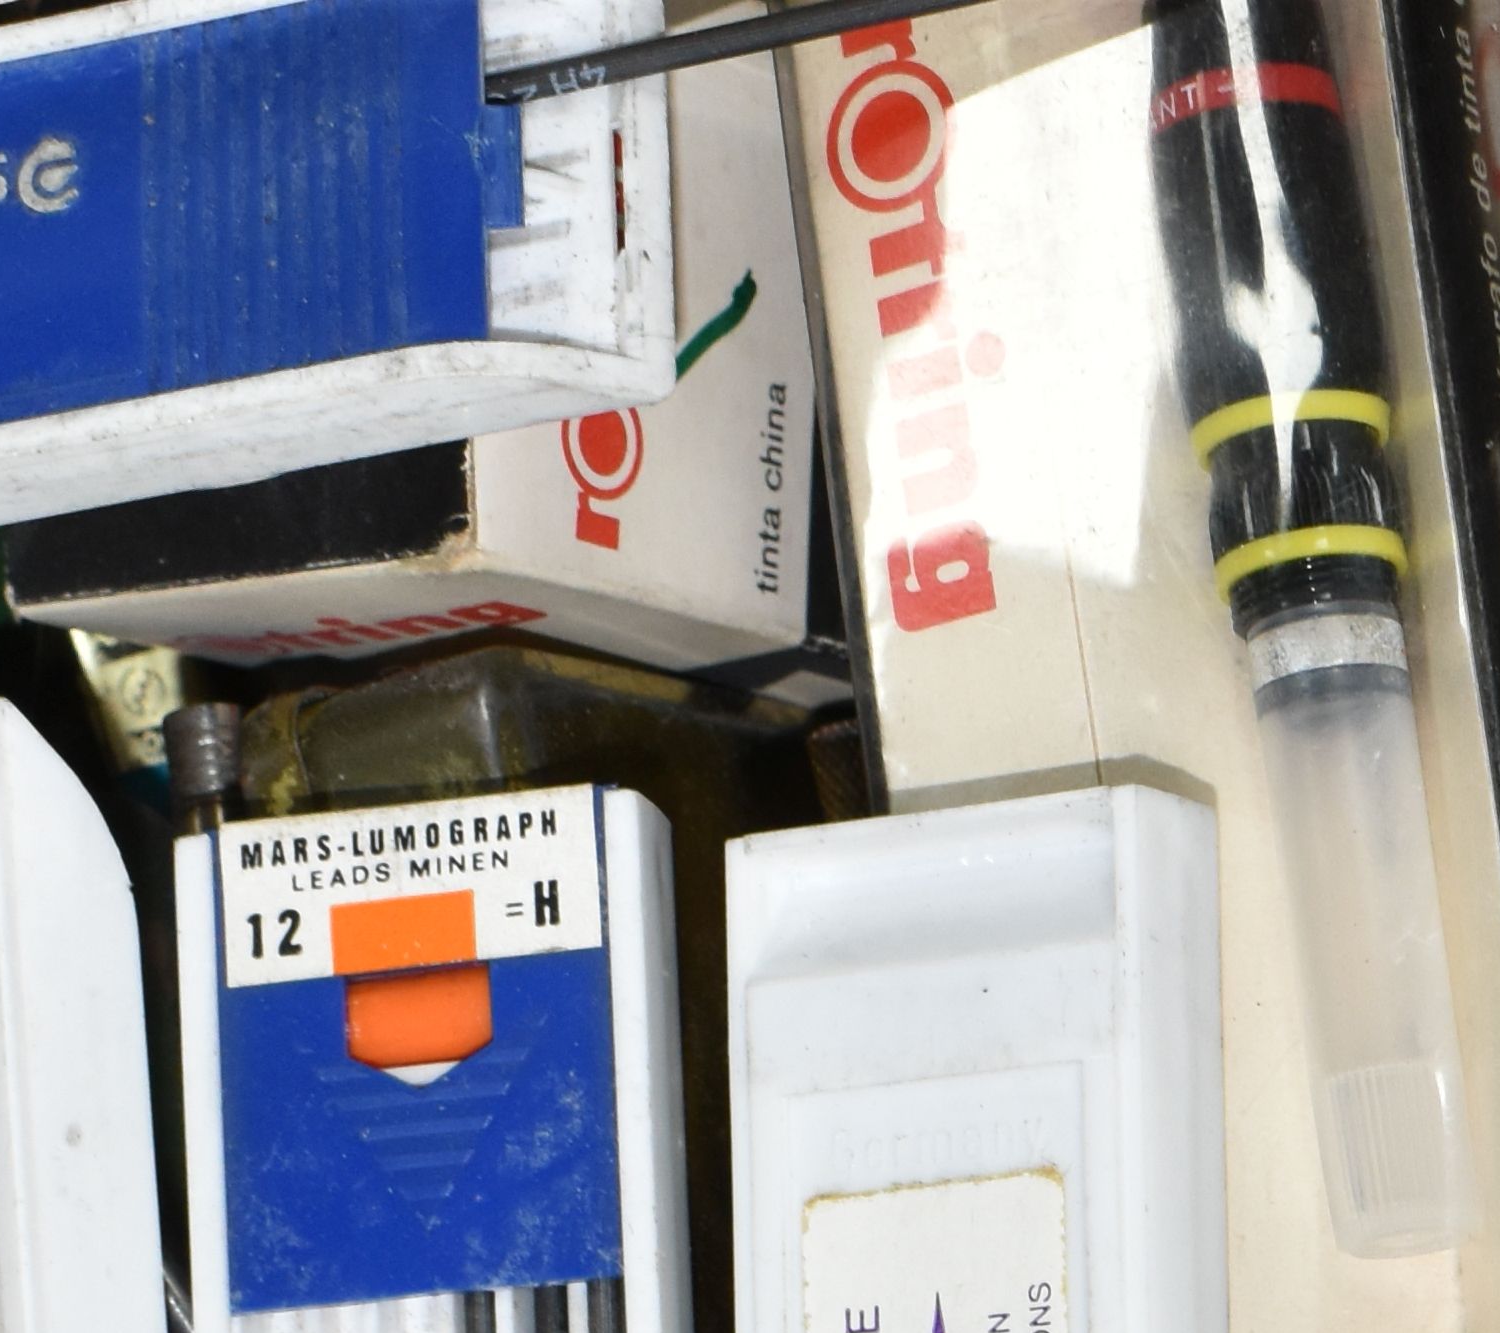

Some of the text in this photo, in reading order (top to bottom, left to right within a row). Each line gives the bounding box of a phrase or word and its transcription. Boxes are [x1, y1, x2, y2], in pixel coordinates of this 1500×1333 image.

[1455, 26, 1482, 134] tinta
[1471, 152, 1492, 211] de
[756, 381, 788, 595] tinta china
[239, 808, 558, 870] MARS-LUMOGRAPH
[290, 849, 510, 892] LEADS MINEN
[245, 908, 303, 960] 12
